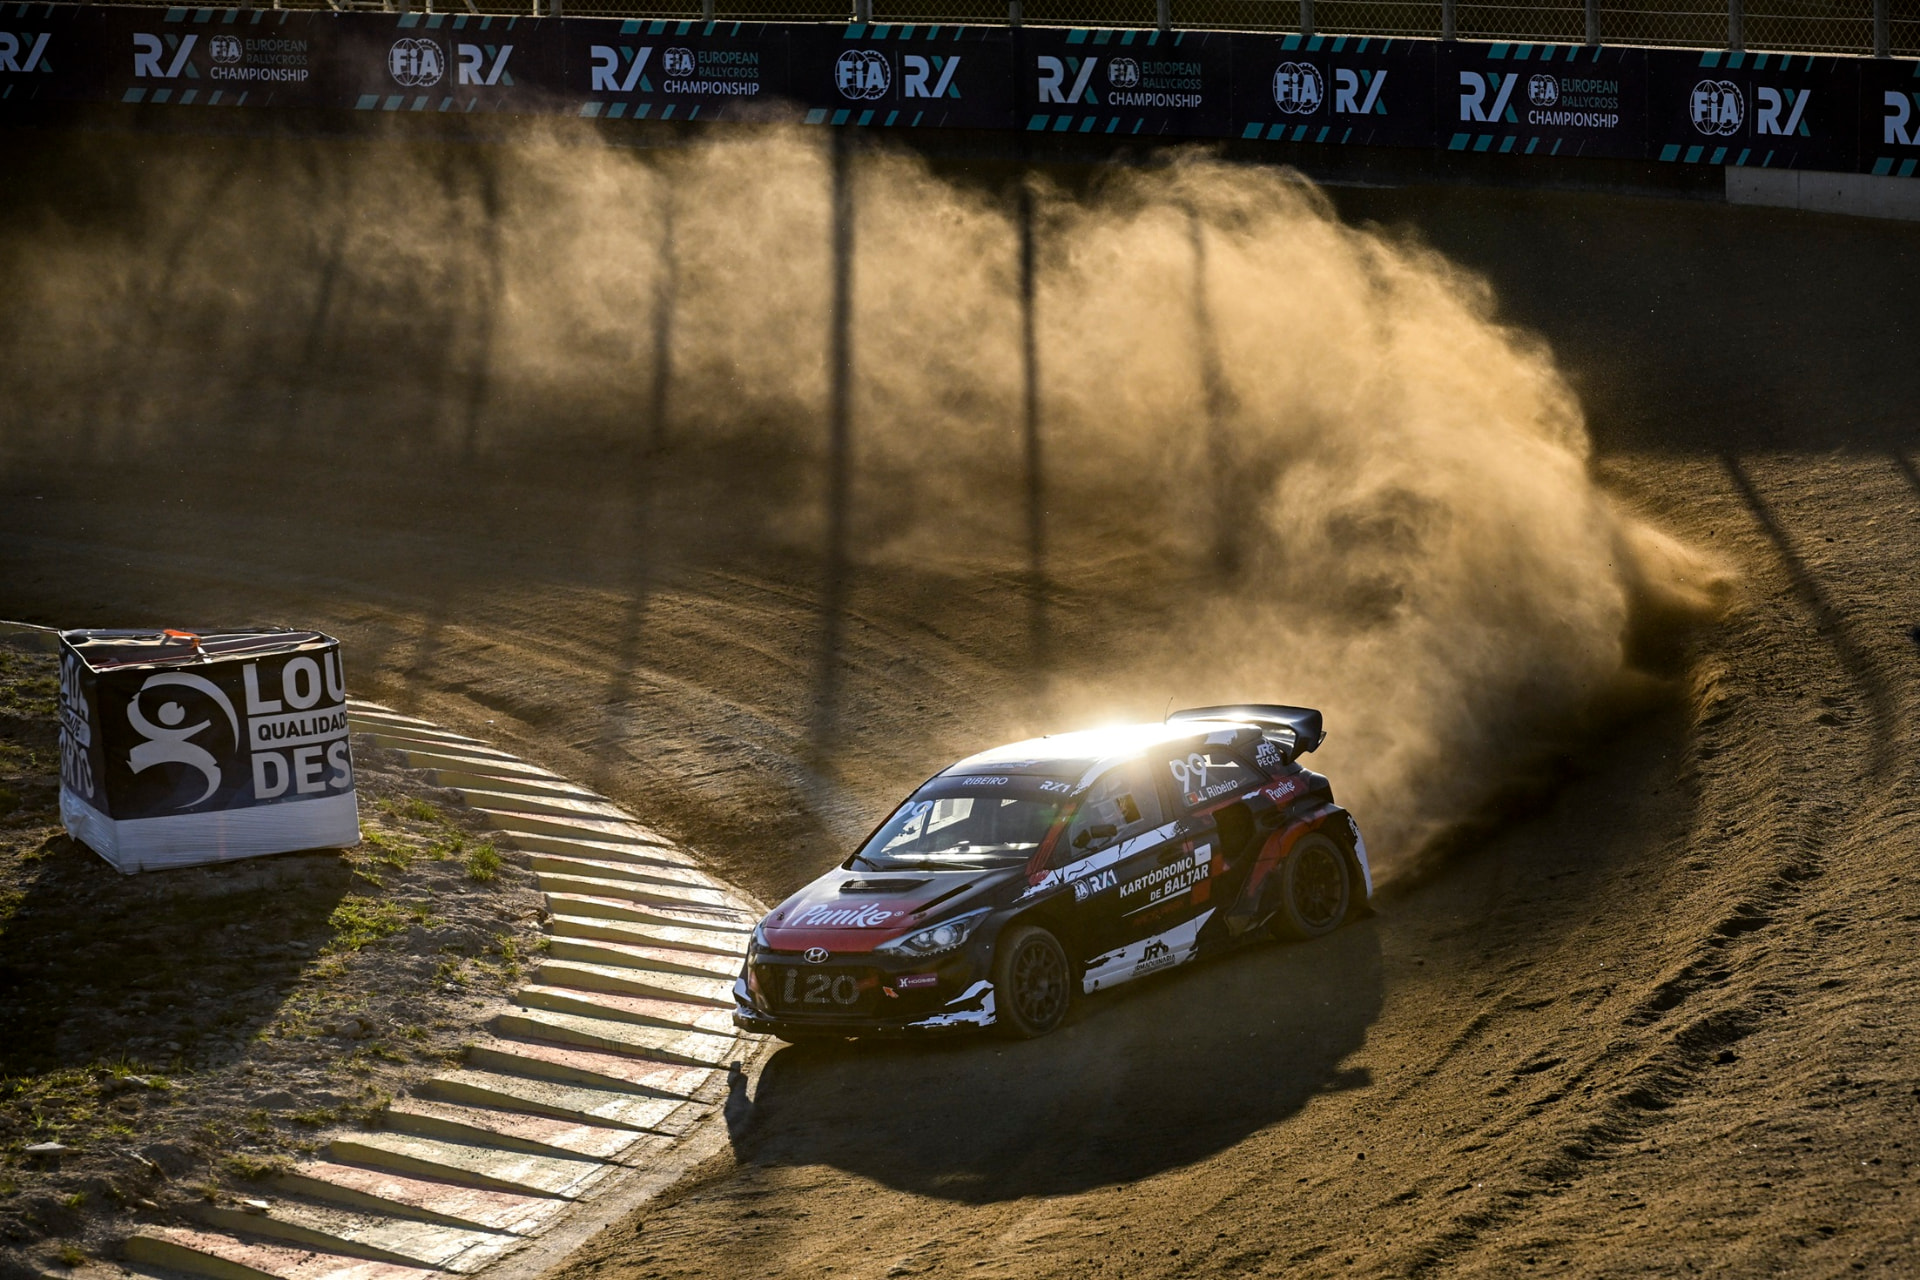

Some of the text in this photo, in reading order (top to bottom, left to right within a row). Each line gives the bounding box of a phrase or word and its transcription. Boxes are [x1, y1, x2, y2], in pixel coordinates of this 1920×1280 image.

[0, 33, 53, 72] RX
[133, 33, 199, 78] RX
[245, 39, 307, 51] EUROPEAN
[246, 53, 308, 65] RALLYCROSS
[458, 44, 514, 86] RX
[590, 45, 653, 91] RX
[698, 50, 759, 65] EUROPEAN
[1142, 60, 1201, 76] EUROPEAN
[210, 66, 309, 82] CHAMPIONSHIP
[699, 66, 759, 78] RALLYCROSS
[904, 55, 961, 98] RX
[1037, 56, 1099, 104] RX
[663, 80, 760, 95] CHAMPIONSHIP
[1143, 77, 1202, 90] RALLYCROSS
[1336, 69, 1388, 115] RX
[1561, 78, 1618, 94] EUROPEAN
[1108, 91, 1202, 108] CHAMPIONSHIP
[1460, 71, 1519, 123] RX
[1561, 95, 1618, 110] RALLYCROSS
[1528, 110, 1619, 128] CHAMPIONSHIP
[1757, 86, 1811, 137] RX
[258, 711, 347, 741] QUALIDAD
[251, 740, 351, 800] DES
[1256, 753, 1281, 768] PEÇAS
[962, 777, 1009, 785] RIBEIRO
[1170, 752, 1207, 794] 99
[1040, 780, 1072, 793] RX1
[1206, 779, 1238, 798] Ribeiro
[1265, 780, 1296, 801] Panike
[1089, 869, 1118, 893] RX1
[1119, 856, 1193, 899] KARTÓDROMO
[1150, 863, 1209, 902] DE BALTAR
[791, 902, 893, 928] Panike
[783, 969, 861, 1005] i20
